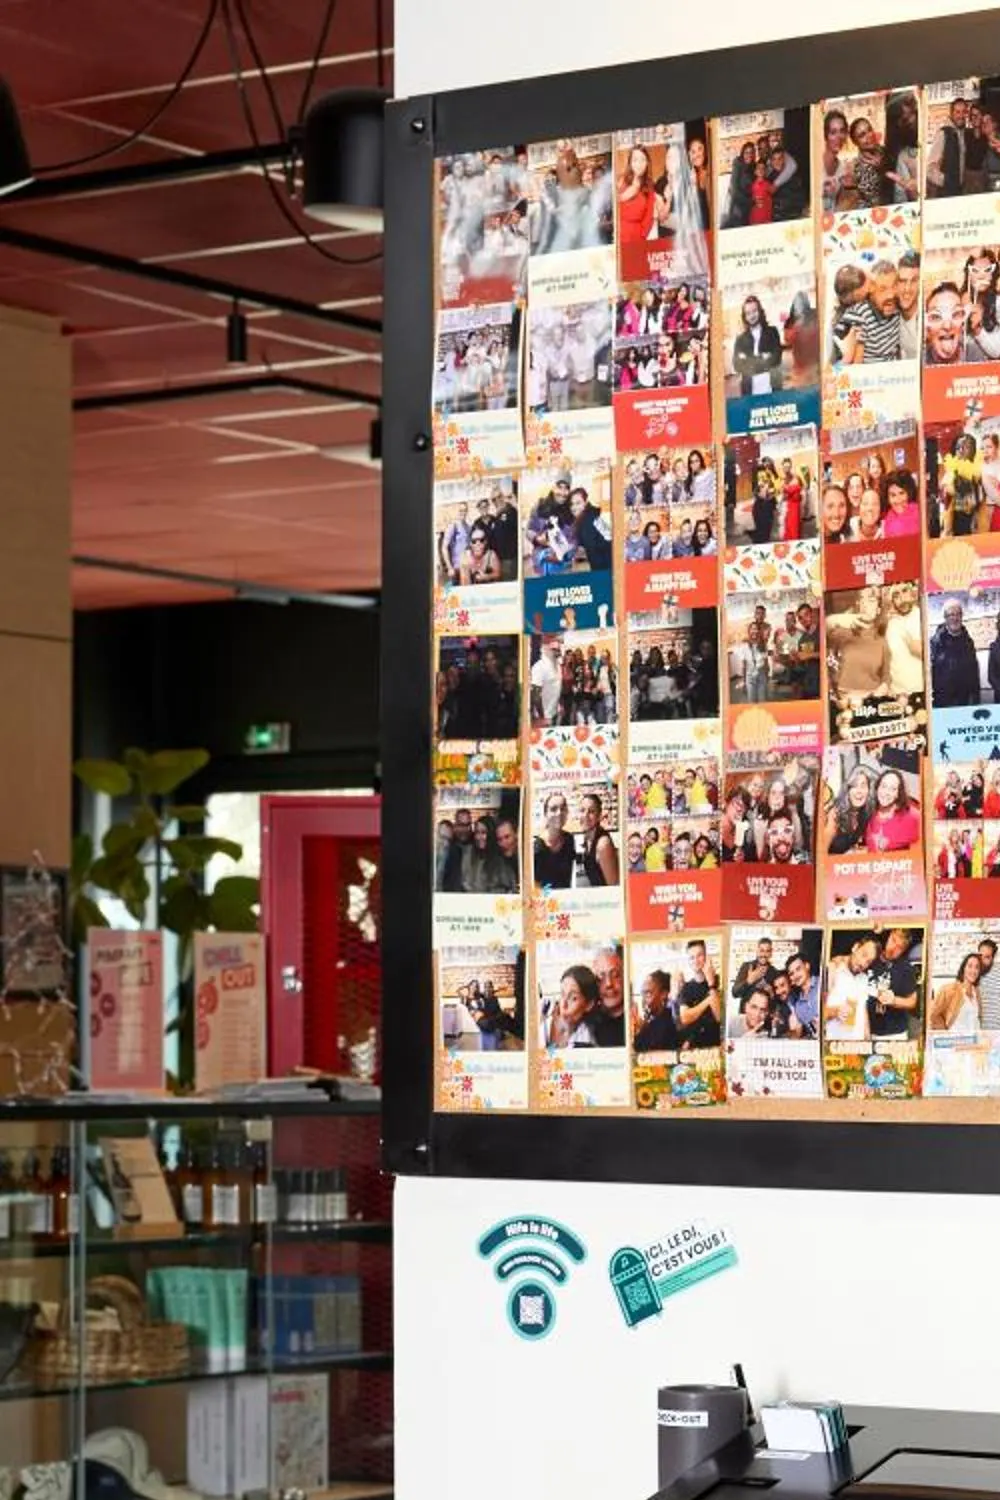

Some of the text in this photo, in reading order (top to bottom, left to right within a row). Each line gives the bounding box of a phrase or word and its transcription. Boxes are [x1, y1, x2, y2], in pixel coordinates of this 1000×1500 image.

[879, 722, 907, 734] PARTY
[948, 726, 981, 736] WINTER
[964, 734, 976, 743] AT
[222, 963, 255, 990] OUT
[774, 1058, 815, 1068] FALL-ING
[763, 1071, 808, 1081] FOR YOU
[668, 1233, 681, 1249] LE
[652, 1251, 685, 1277] C'EST
[685, 1233, 721, 1259] VOUS
